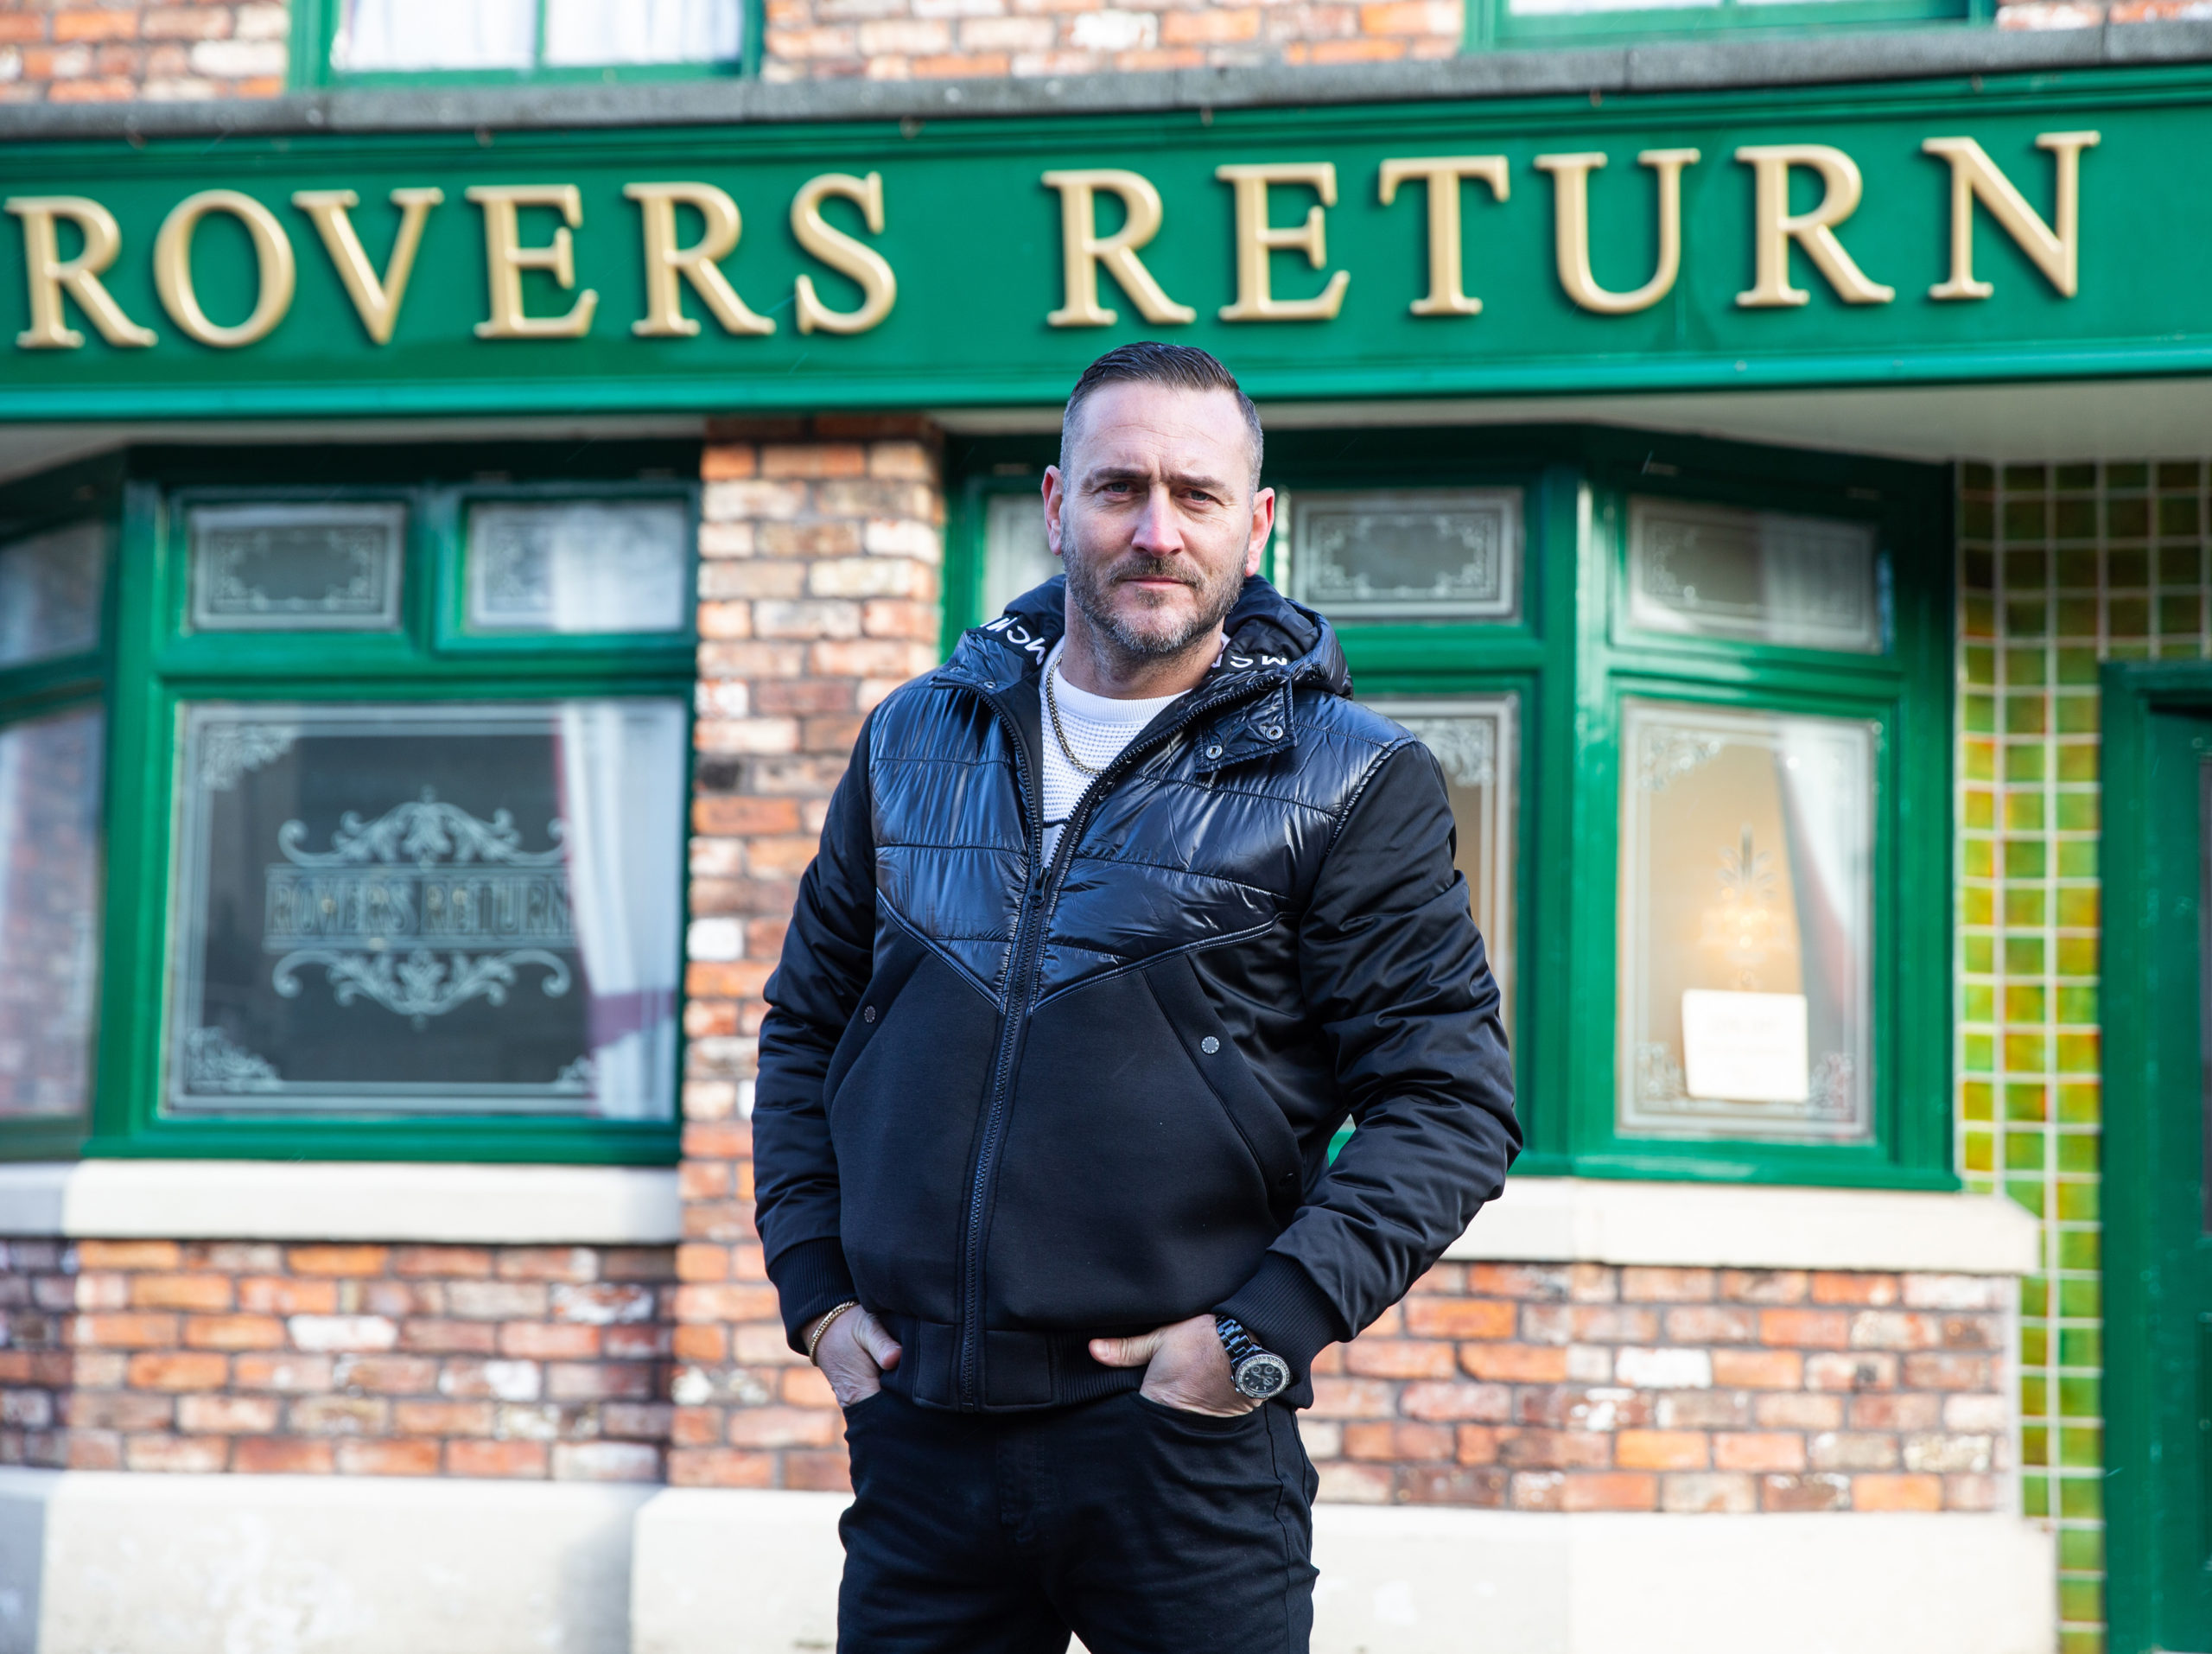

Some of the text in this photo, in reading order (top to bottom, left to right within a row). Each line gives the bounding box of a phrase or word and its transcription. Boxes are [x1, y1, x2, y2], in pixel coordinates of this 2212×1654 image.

[7, 130, 2101, 348] ROVERS RETURN
[270, 875, 418, 935] ROVERS
